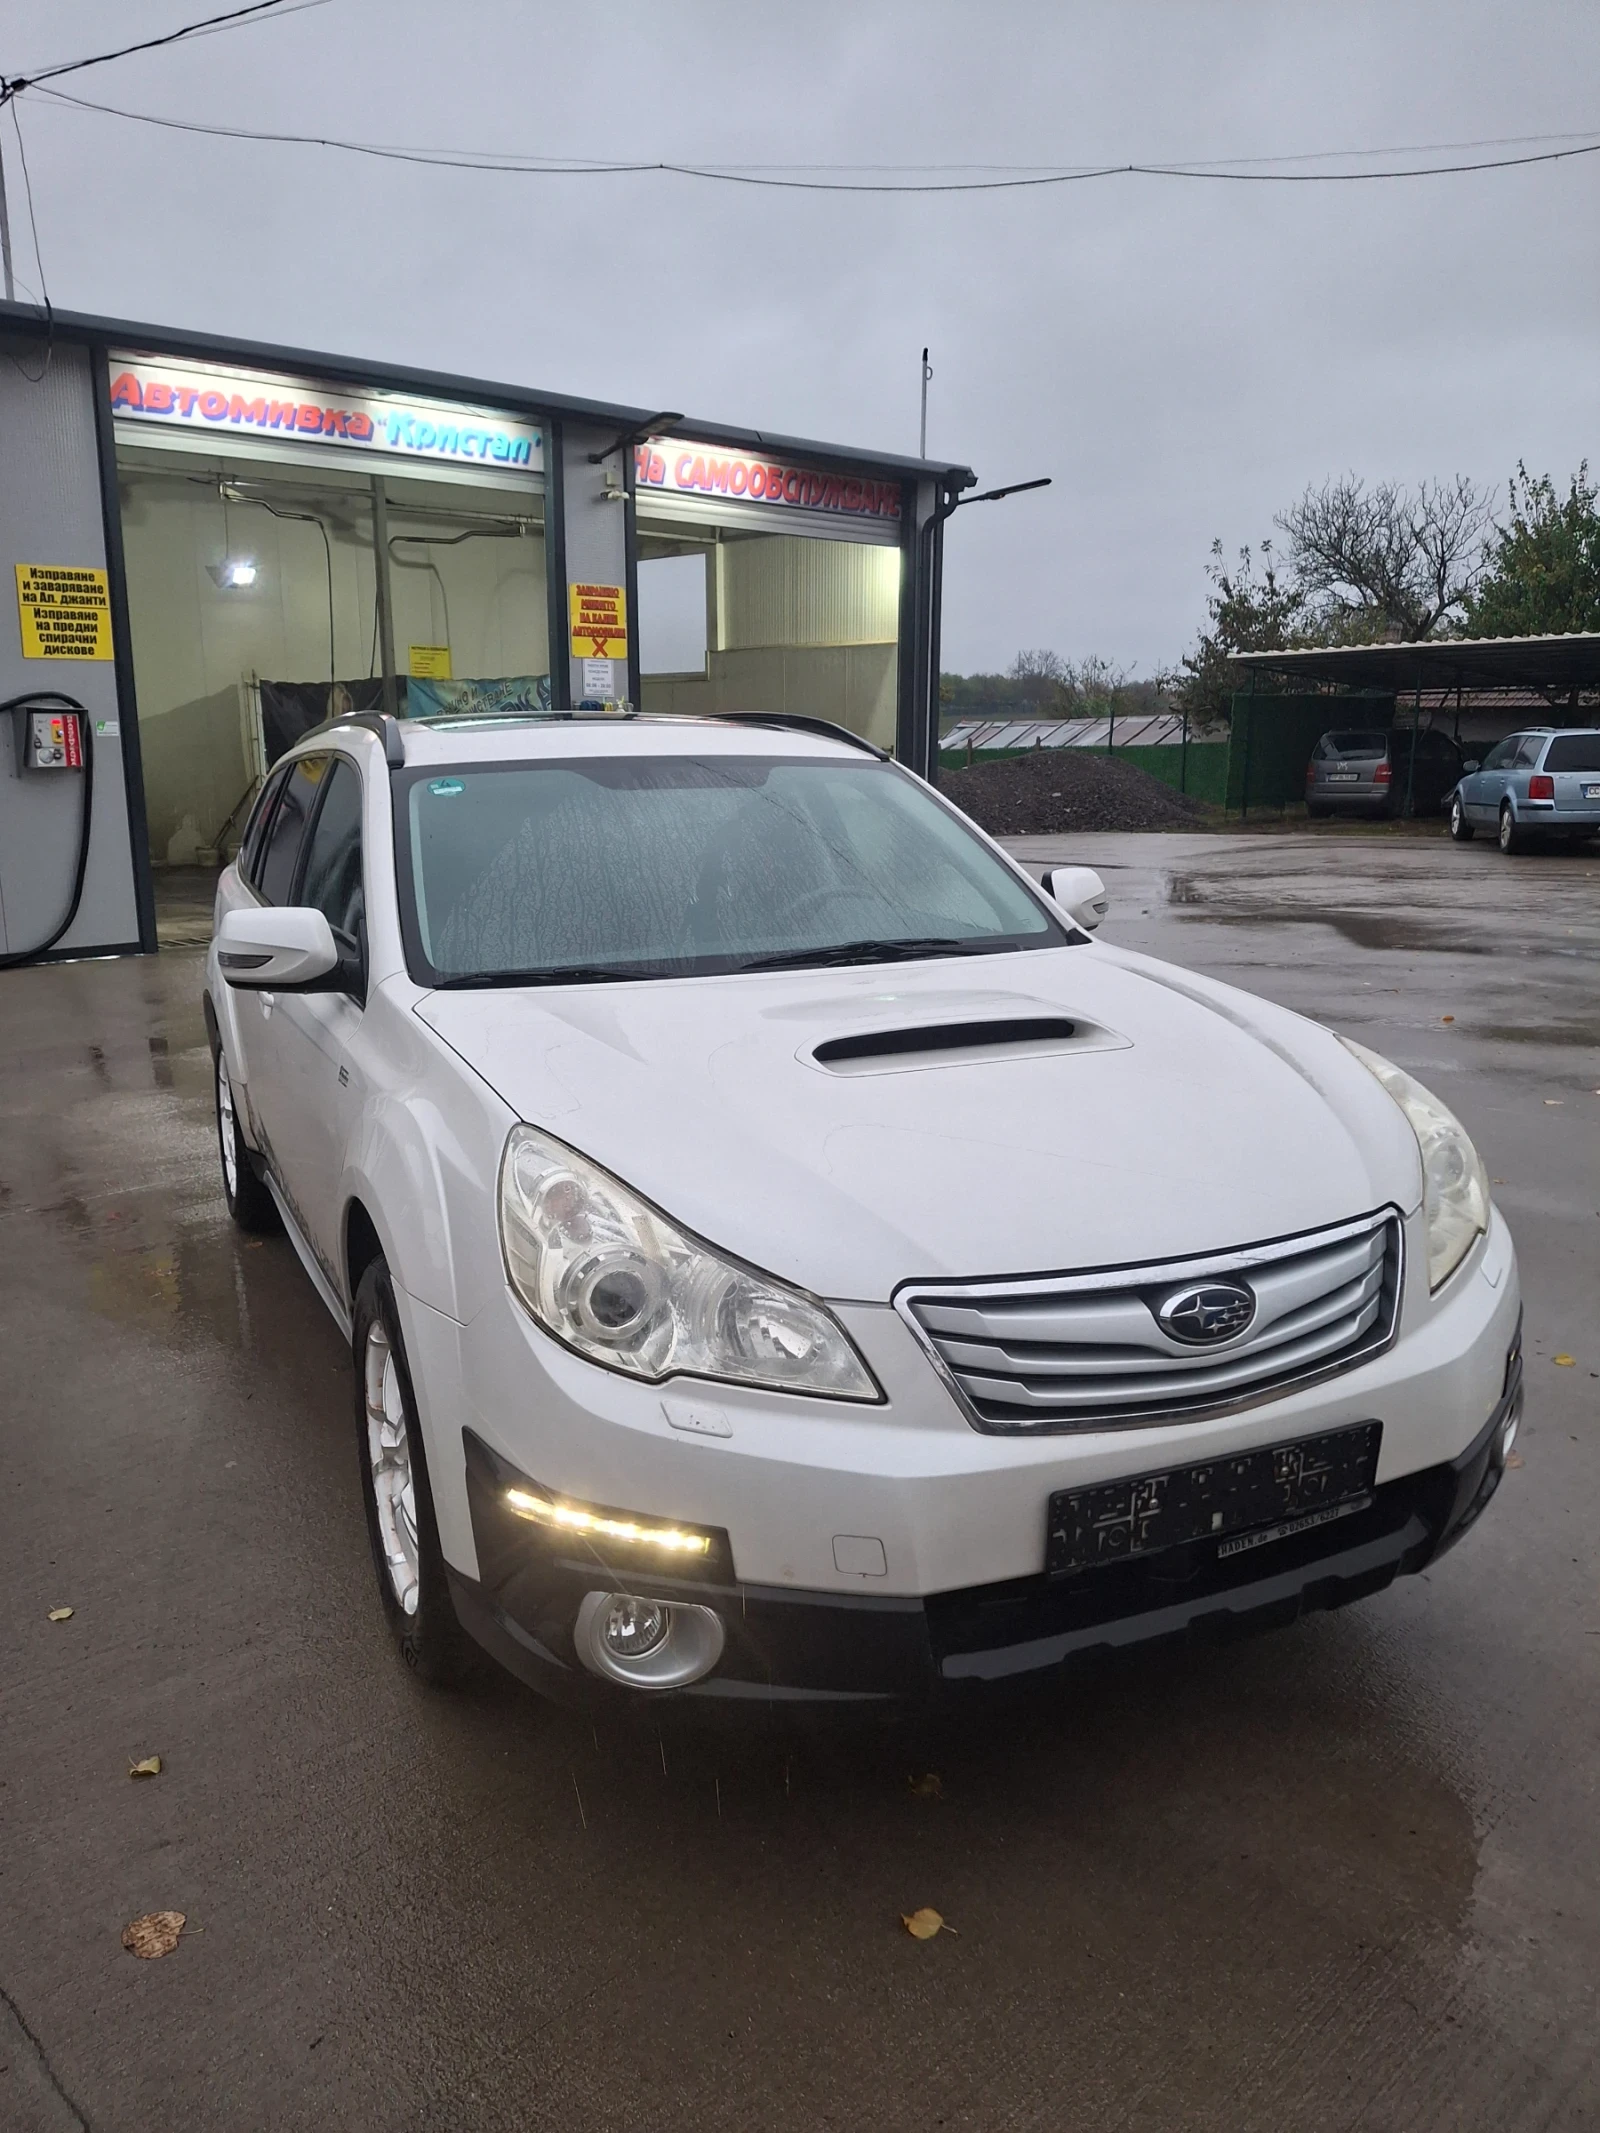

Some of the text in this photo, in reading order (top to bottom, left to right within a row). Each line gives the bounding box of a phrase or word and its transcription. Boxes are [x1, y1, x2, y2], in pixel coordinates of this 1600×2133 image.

[30, 567, 95, 582] Изправяне
[33, 582, 104, 594] заваряване
[22, 592, 106, 606] на Ал. джанти
[33, 607, 98, 621] Изправяне
[36, 621, 98, 633] на предни
[39, 633, 97, 645] спирачни
[44, 645, 95, 655] дискове
[1219, 1533, 1268, 1556] HADEN.de
